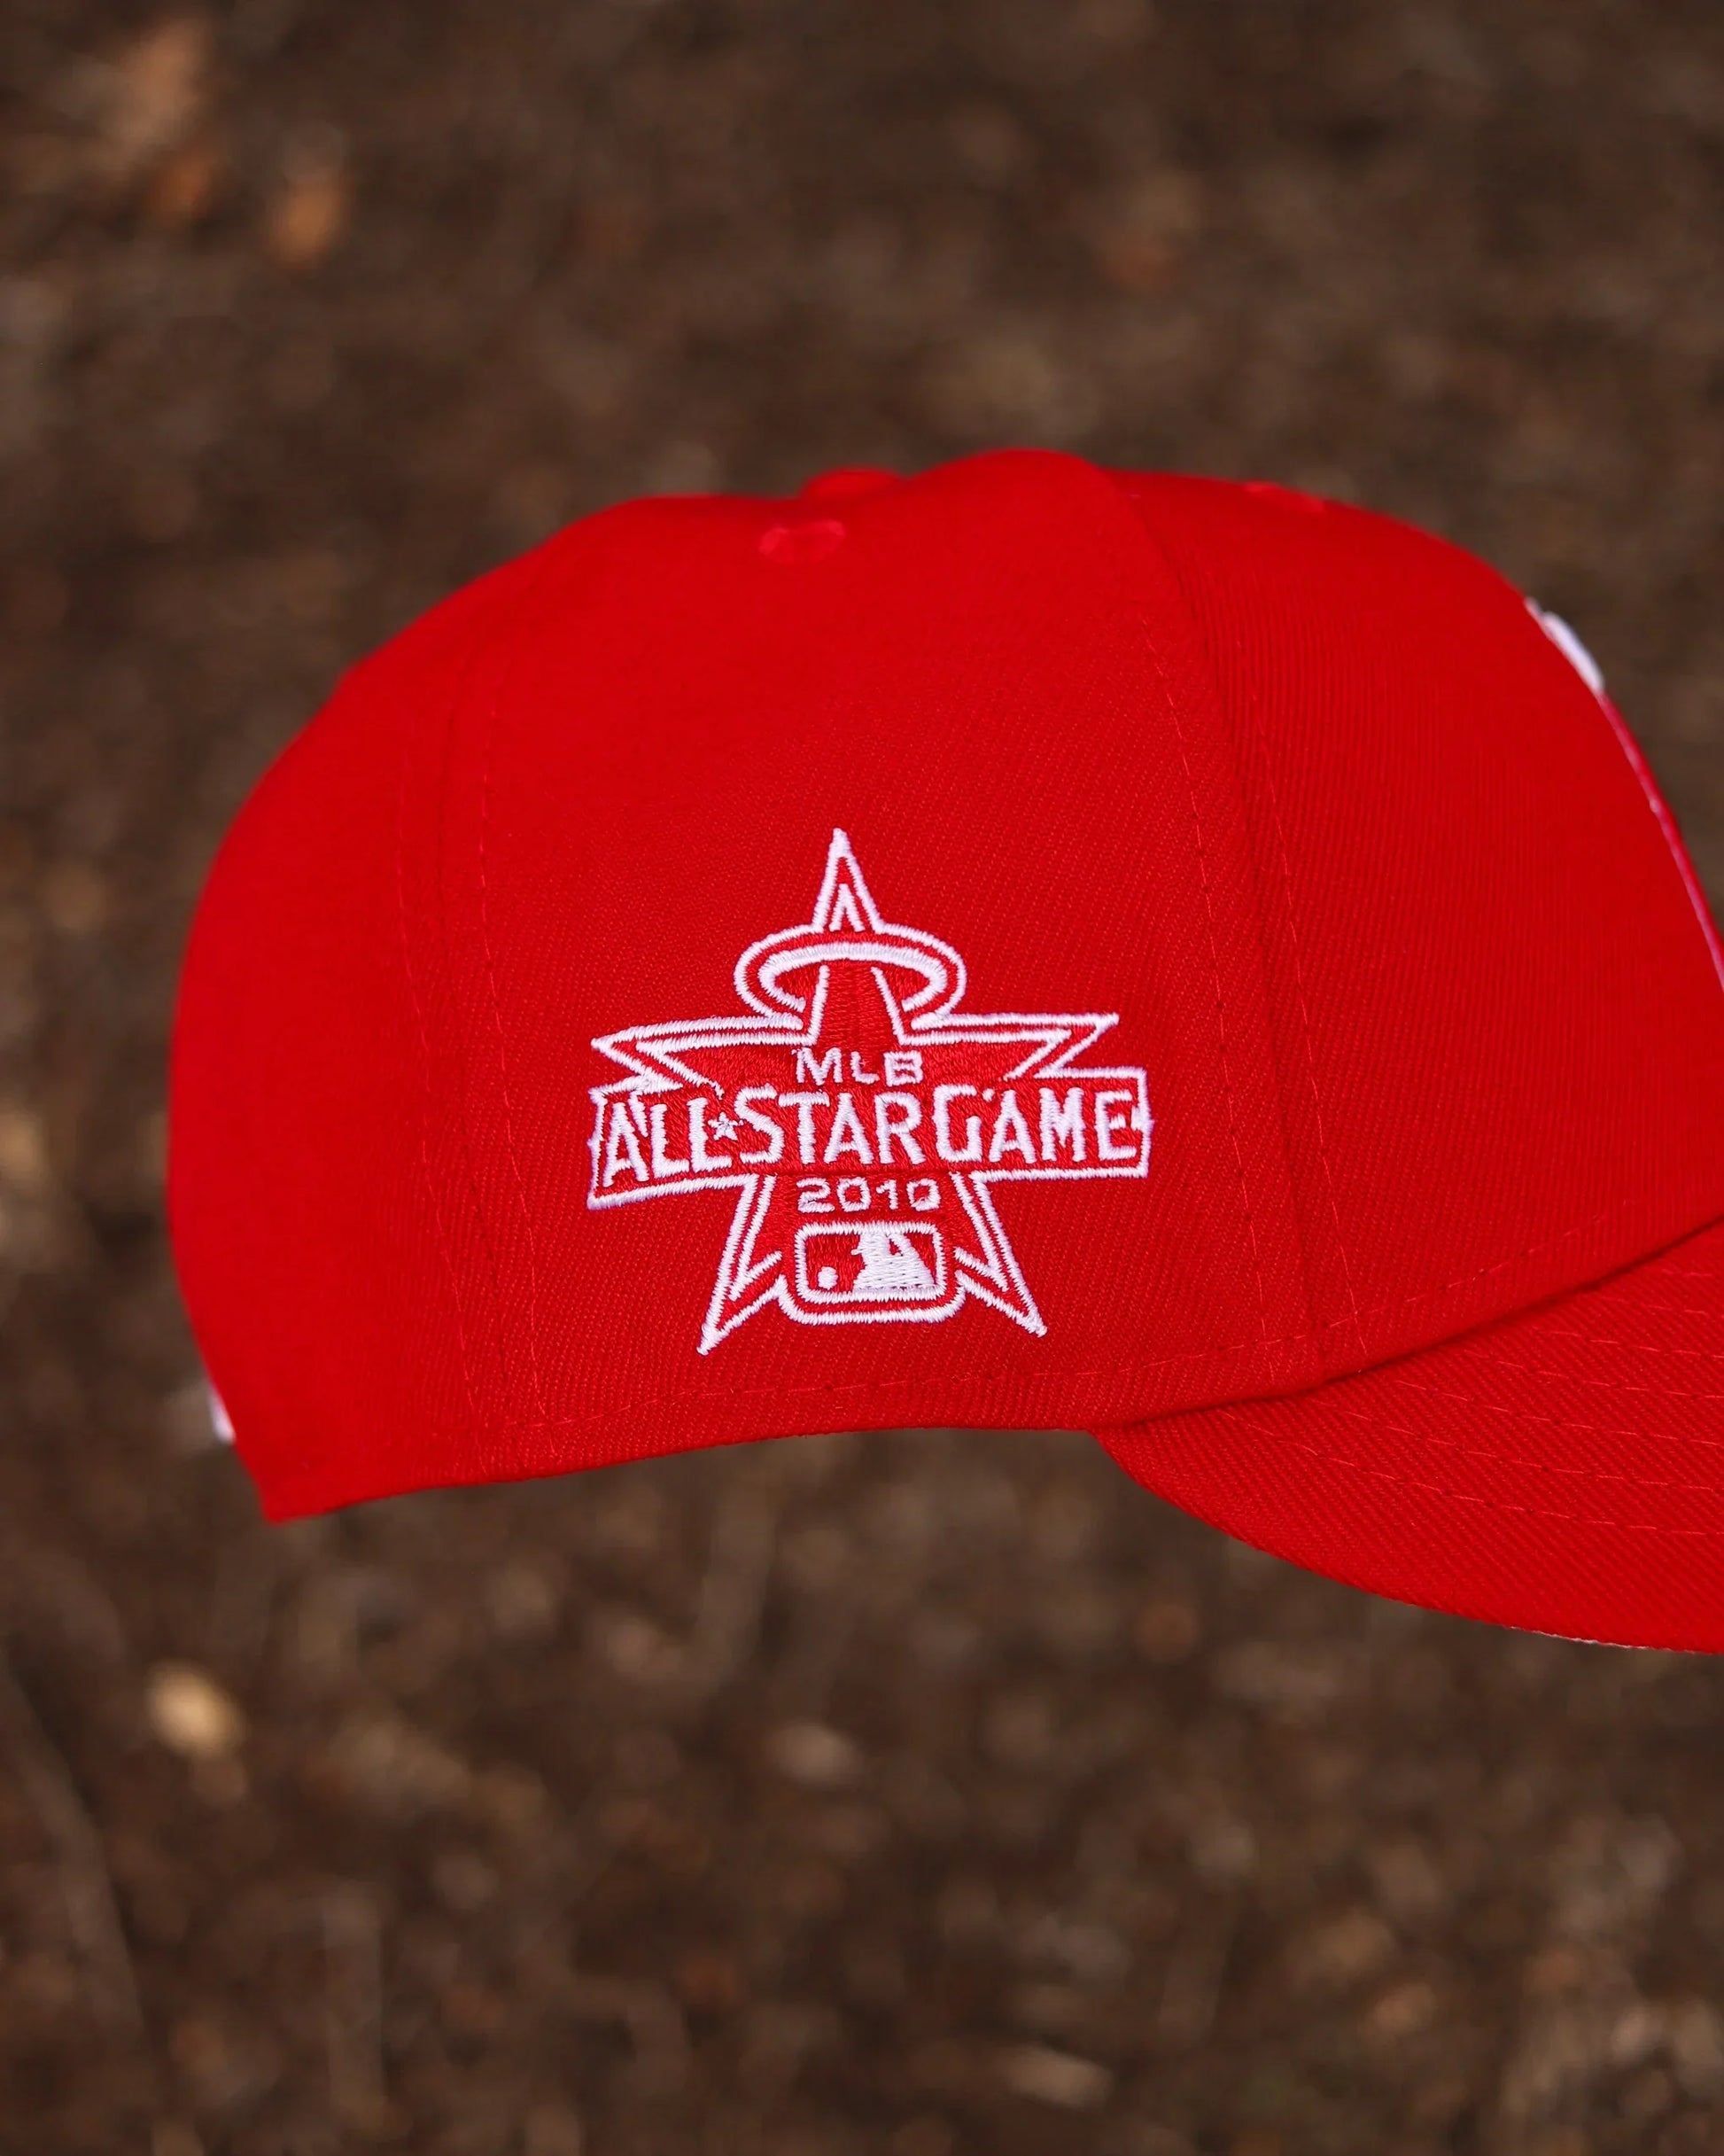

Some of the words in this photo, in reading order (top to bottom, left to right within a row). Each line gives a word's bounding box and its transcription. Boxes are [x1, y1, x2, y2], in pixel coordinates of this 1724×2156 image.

[796, 1047, 923, 1086] MLB
[933, 1084, 1138, 1163] GAME
[797, 1177, 941, 1213] 2010
